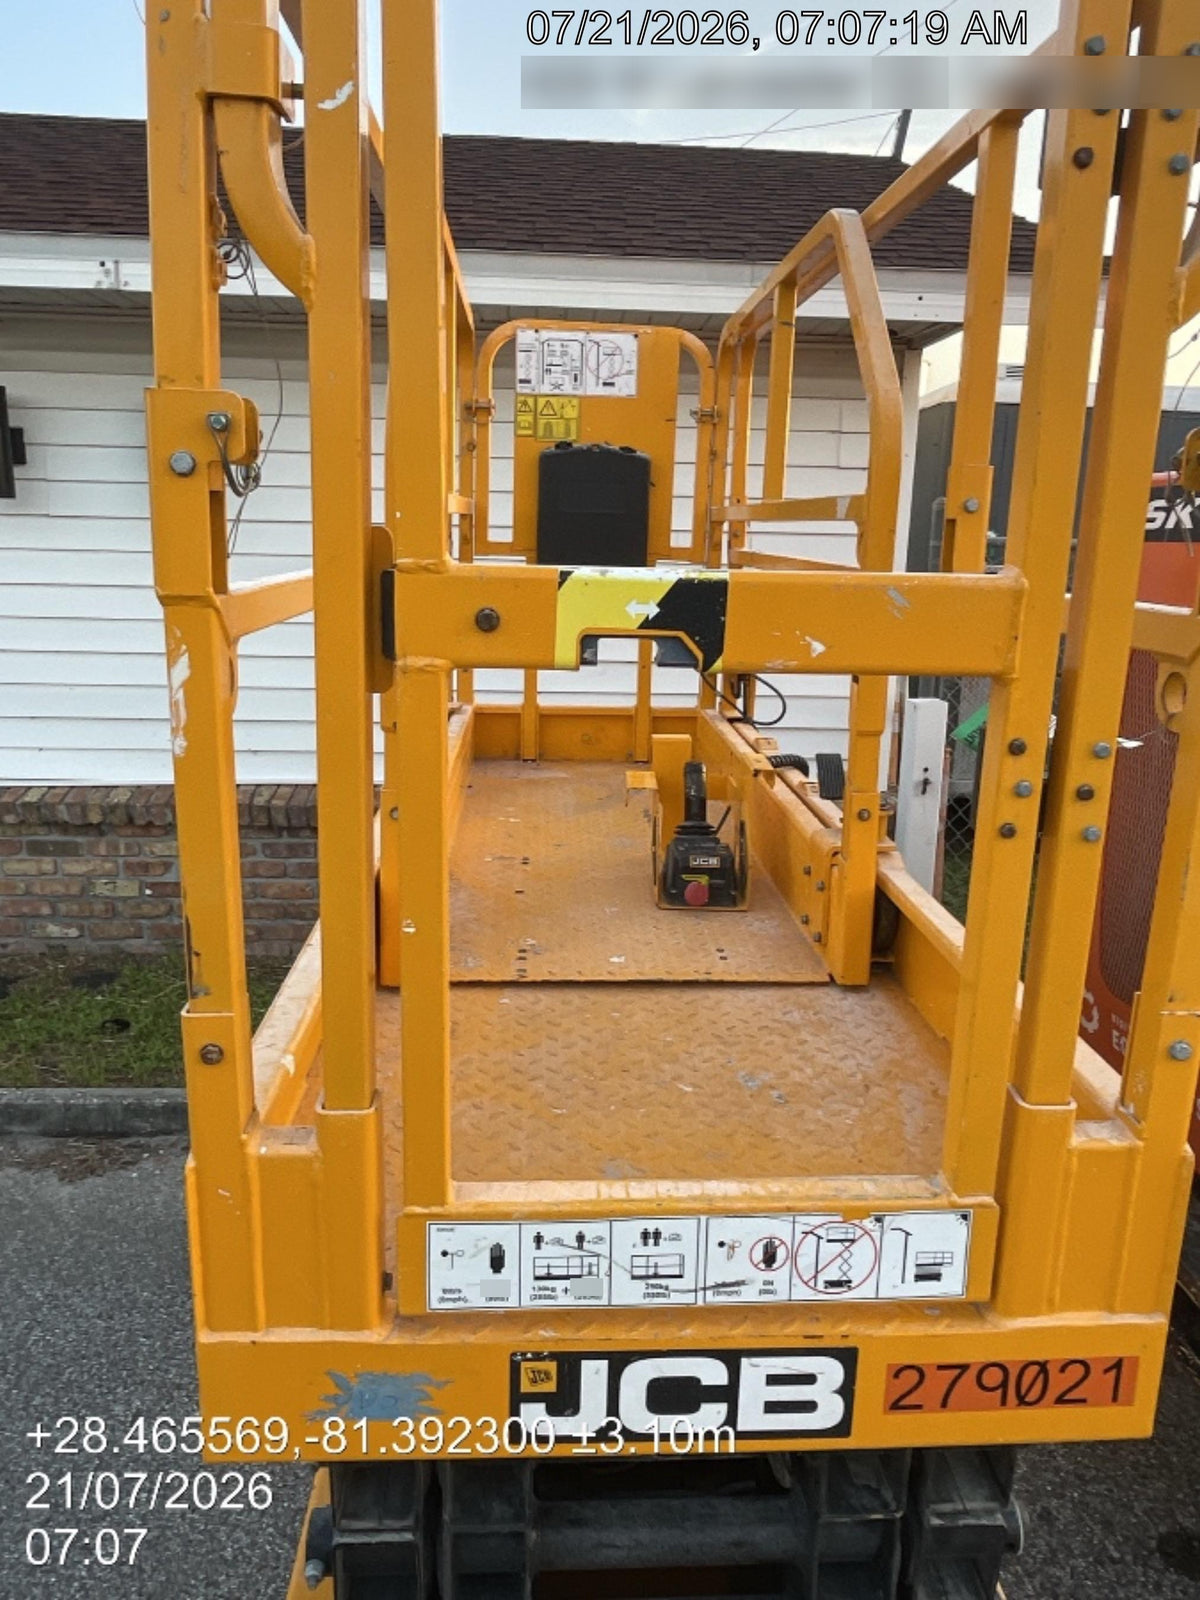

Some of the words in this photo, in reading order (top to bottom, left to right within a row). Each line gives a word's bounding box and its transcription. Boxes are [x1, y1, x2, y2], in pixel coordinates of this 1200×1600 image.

[1145, 497, 1200, 531] SK
[692, 857, 718, 865] JCB
[519, 1355, 846, 1436] JCB
[888, 1358, 1125, 1412] 279021
